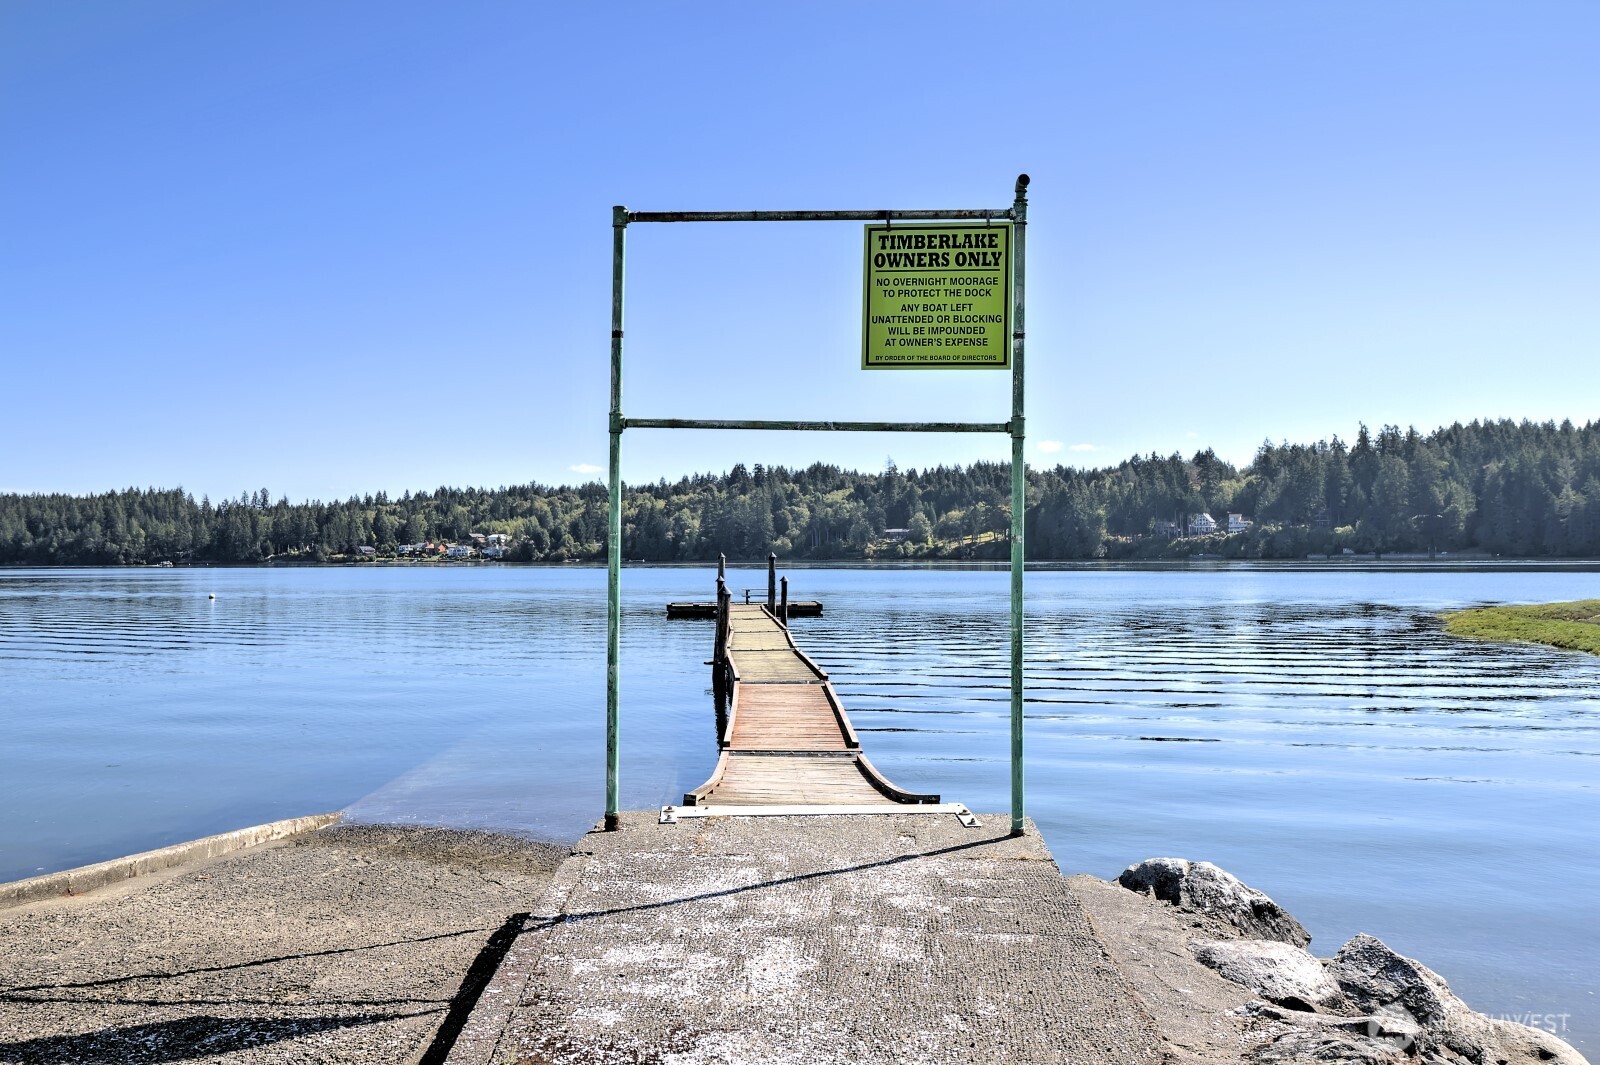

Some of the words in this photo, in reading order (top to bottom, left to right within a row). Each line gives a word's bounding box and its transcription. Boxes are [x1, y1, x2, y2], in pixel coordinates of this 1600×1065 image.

[879, 234, 998, 250] TIMBERLAKE
[874, 253, 949, 268] OWNERS
[955, 252, 1002, 266] ONLY
[893, 278, 947, 286] OVERNIGHT
[950, 277, 998, 285] MOORAGE
